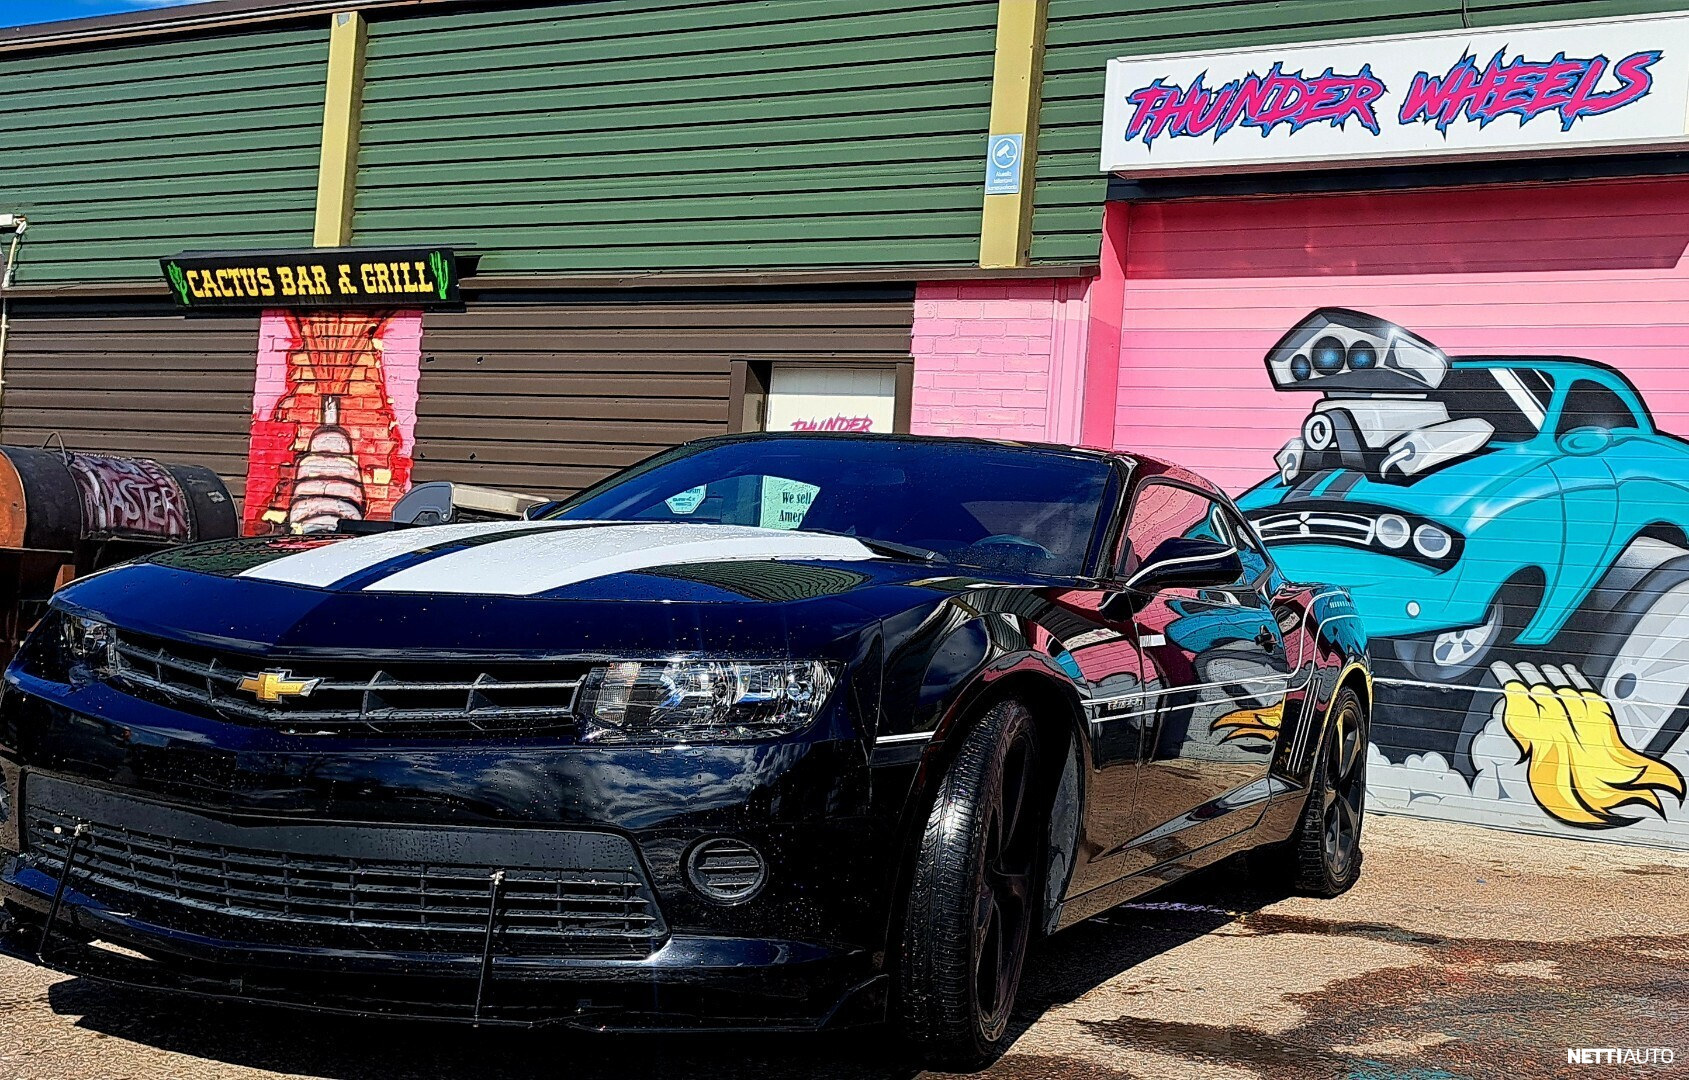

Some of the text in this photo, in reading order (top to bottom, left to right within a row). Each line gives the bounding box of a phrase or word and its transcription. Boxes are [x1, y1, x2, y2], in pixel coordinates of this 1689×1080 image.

[1124, 44, 1664, 151] THUNDER WHEELS
[186, 261, 434, 298] CACTUS BAR & GRILL
[790, 412, 874, 432] THUNDER
[82, 474, 188, 535] MASTER
[782, 491, 812, 504] We sell
